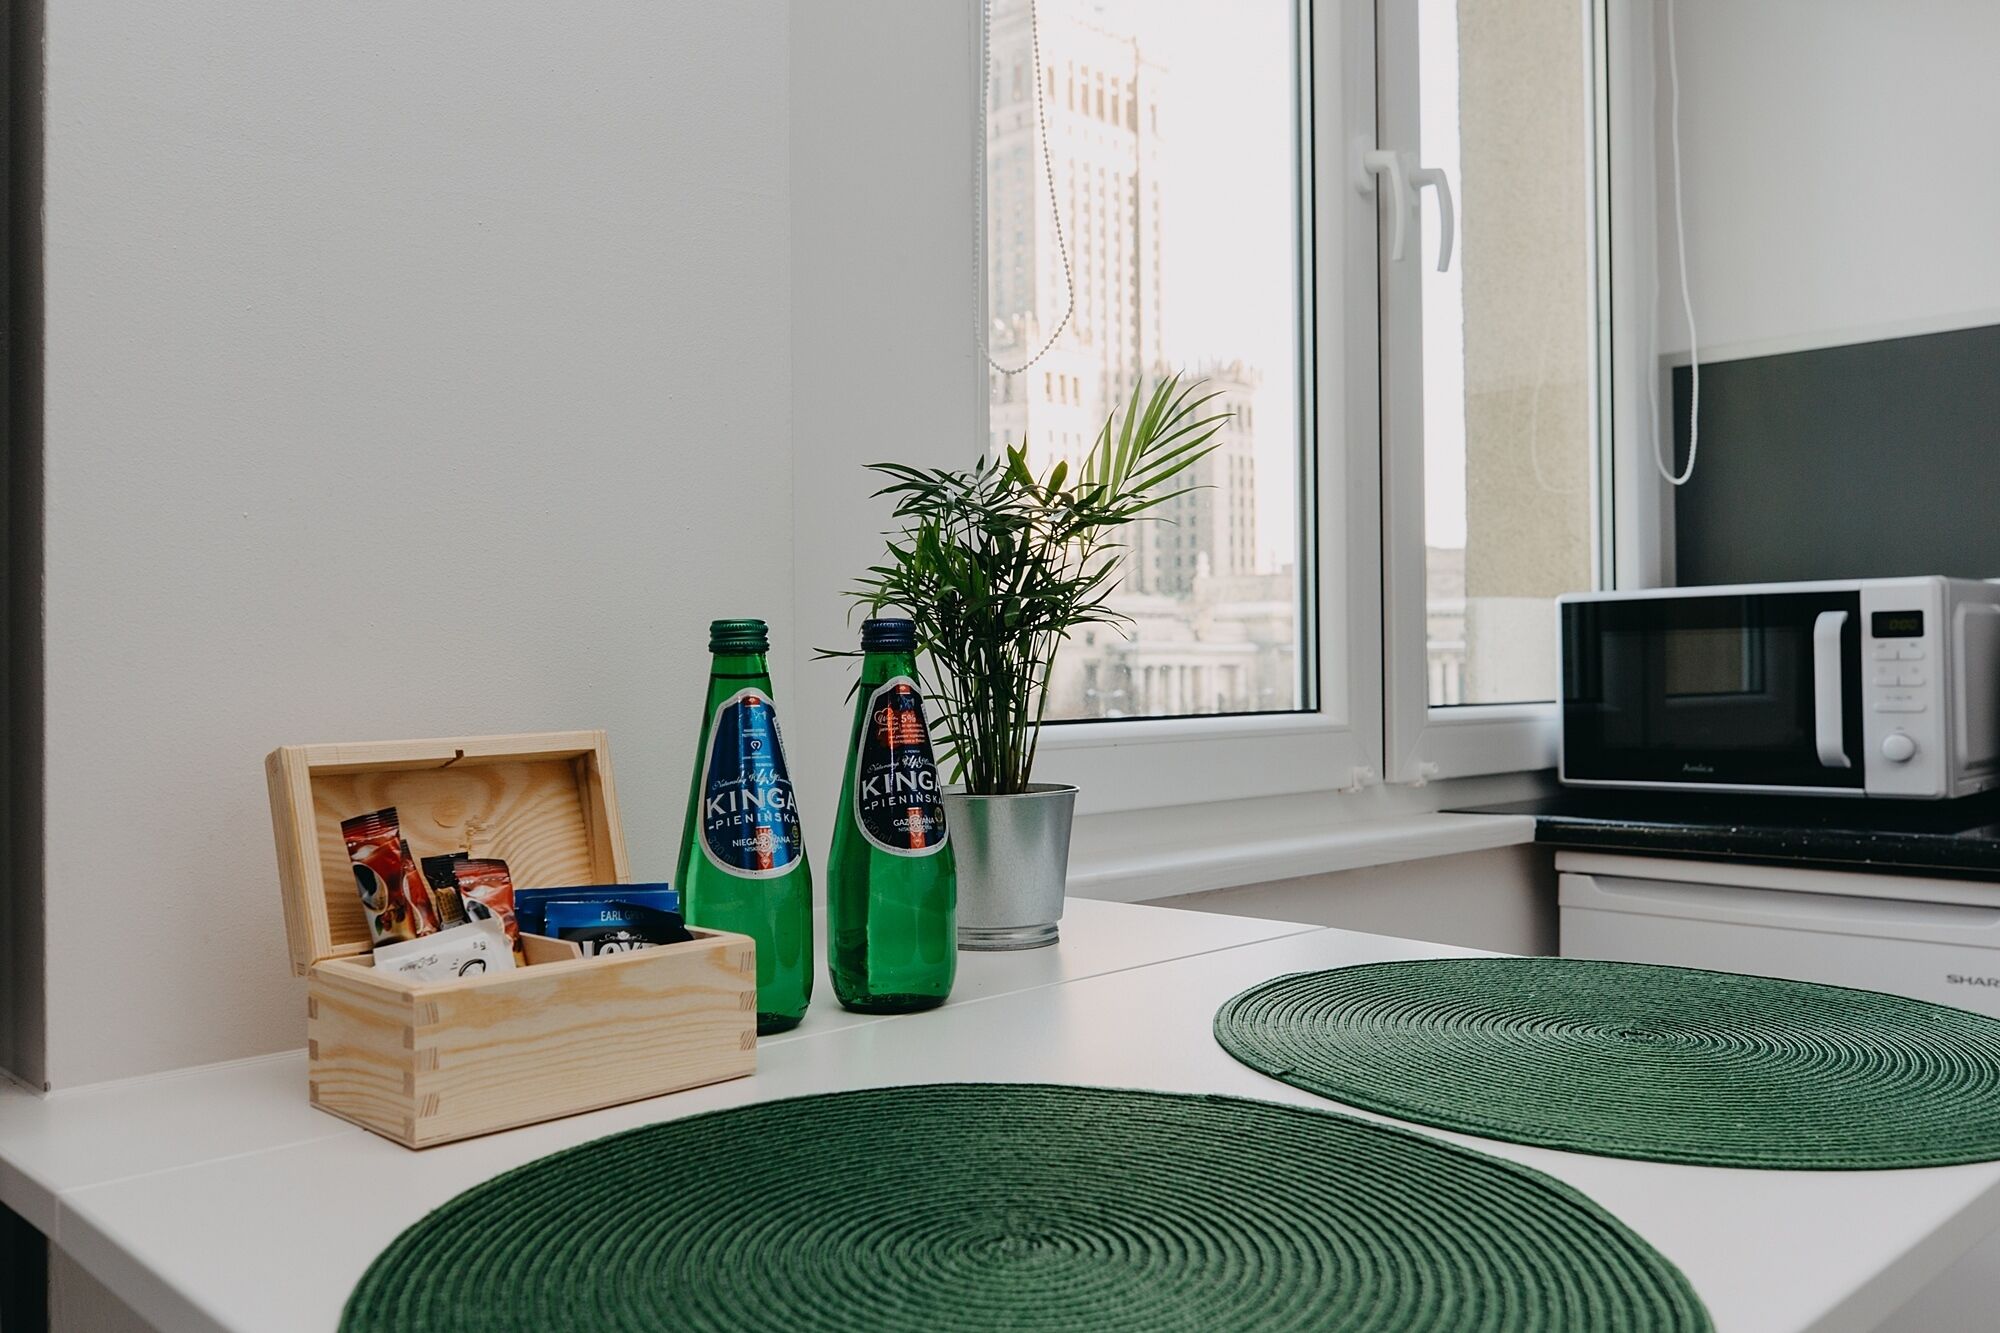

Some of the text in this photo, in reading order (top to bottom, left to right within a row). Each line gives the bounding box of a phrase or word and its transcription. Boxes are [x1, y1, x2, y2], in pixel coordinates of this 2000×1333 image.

[861, 770, 943, 800] KINGA
[706, 787, 798, 819] KINGA
[893, 817, 935, 827] GAZANA
[732, 835, 791, 847] NIEGAANA
[601, 910, 622, 921] EARL
